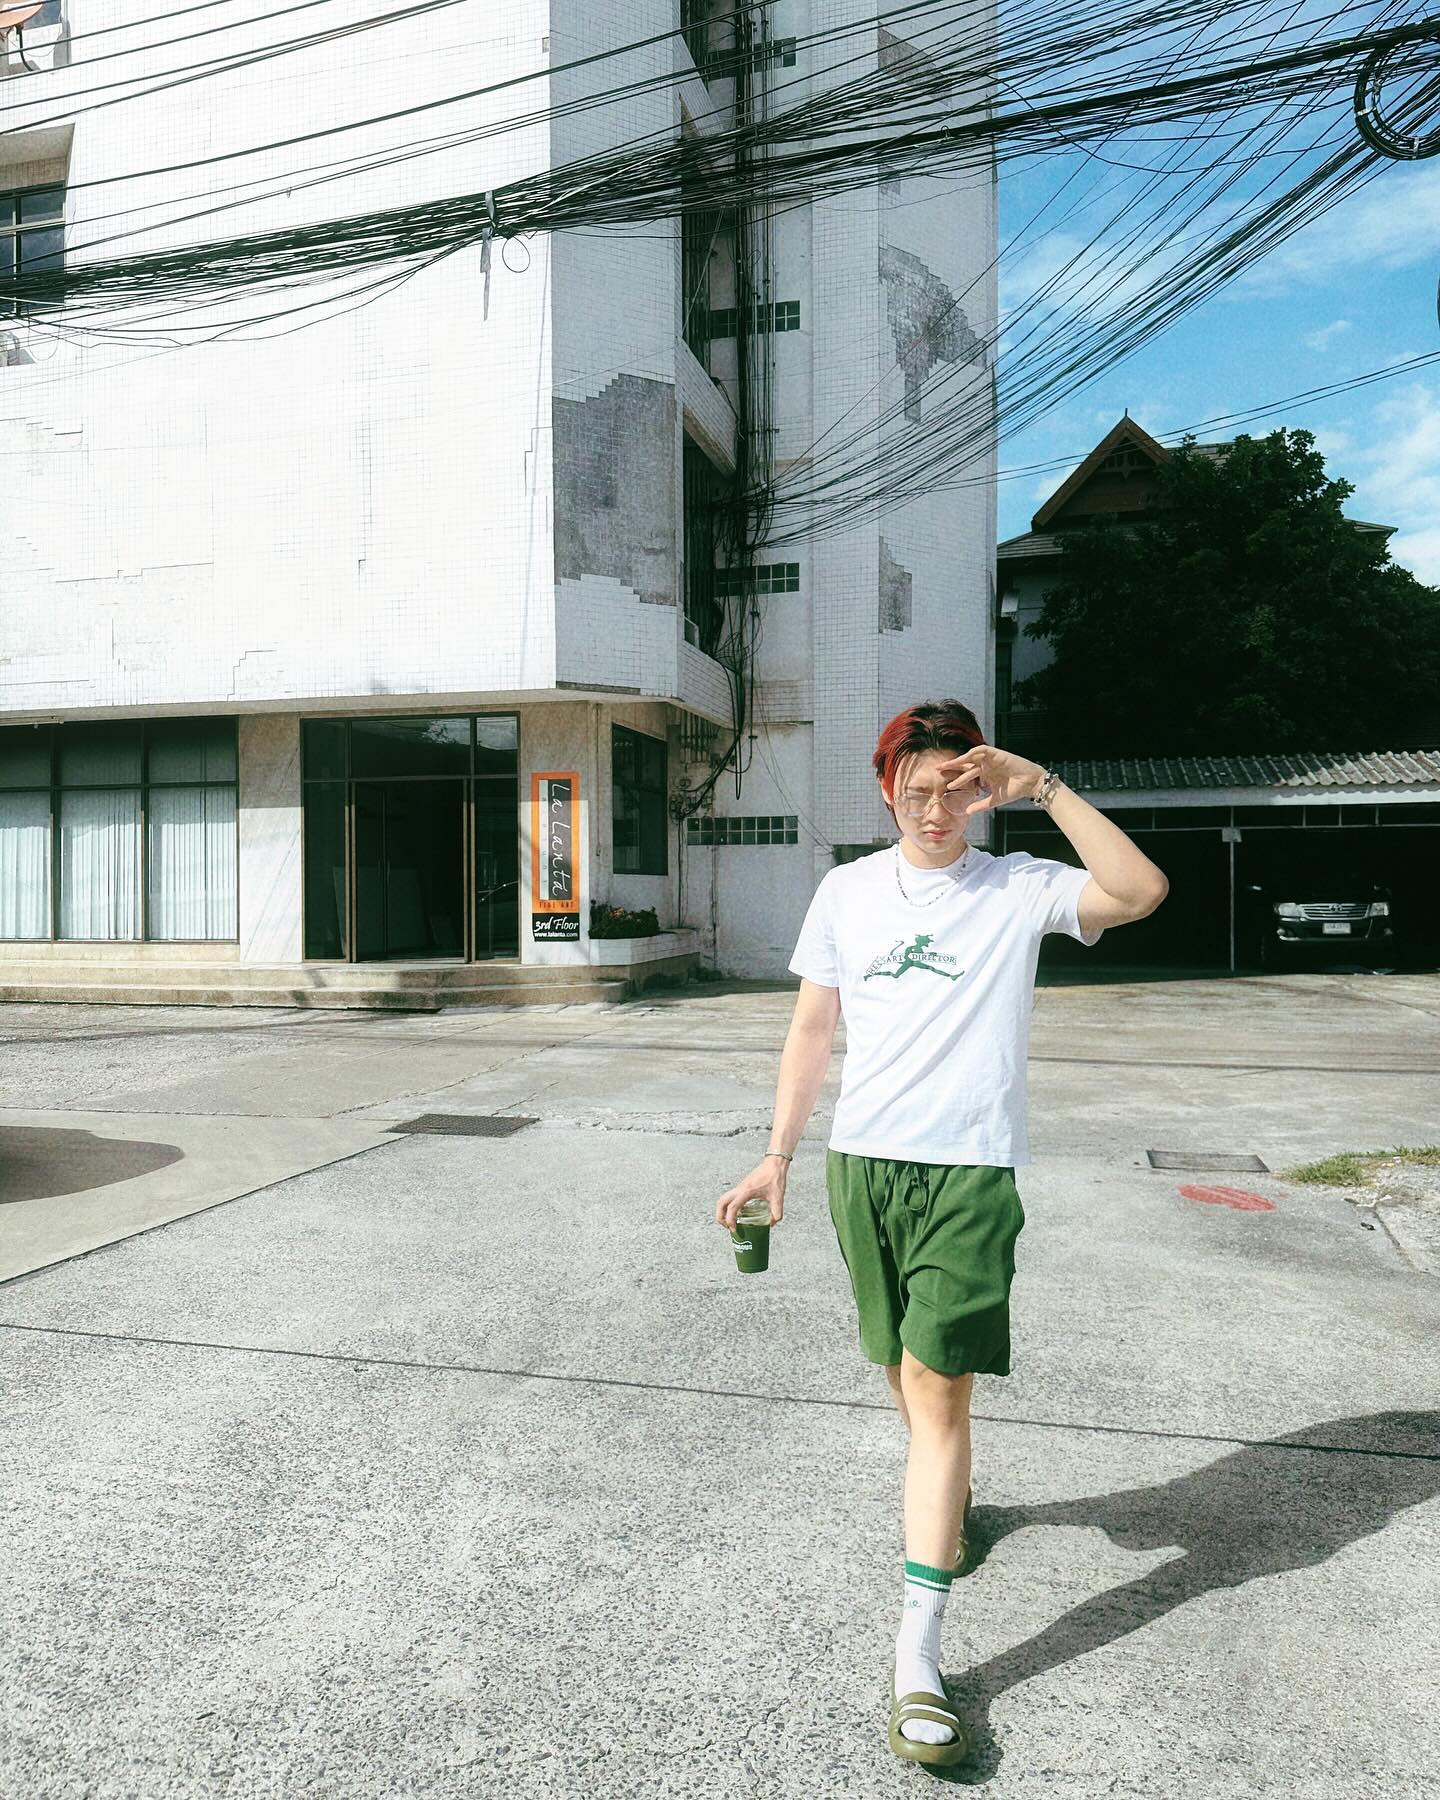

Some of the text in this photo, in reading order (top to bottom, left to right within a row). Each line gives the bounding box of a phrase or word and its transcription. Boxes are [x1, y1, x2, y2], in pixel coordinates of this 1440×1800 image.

[552, 783, 571, 897] La Lanta
[534, 916, 579, 933] 3rd Floor
[886, 953, 956, 964] ART DIRECTOR
